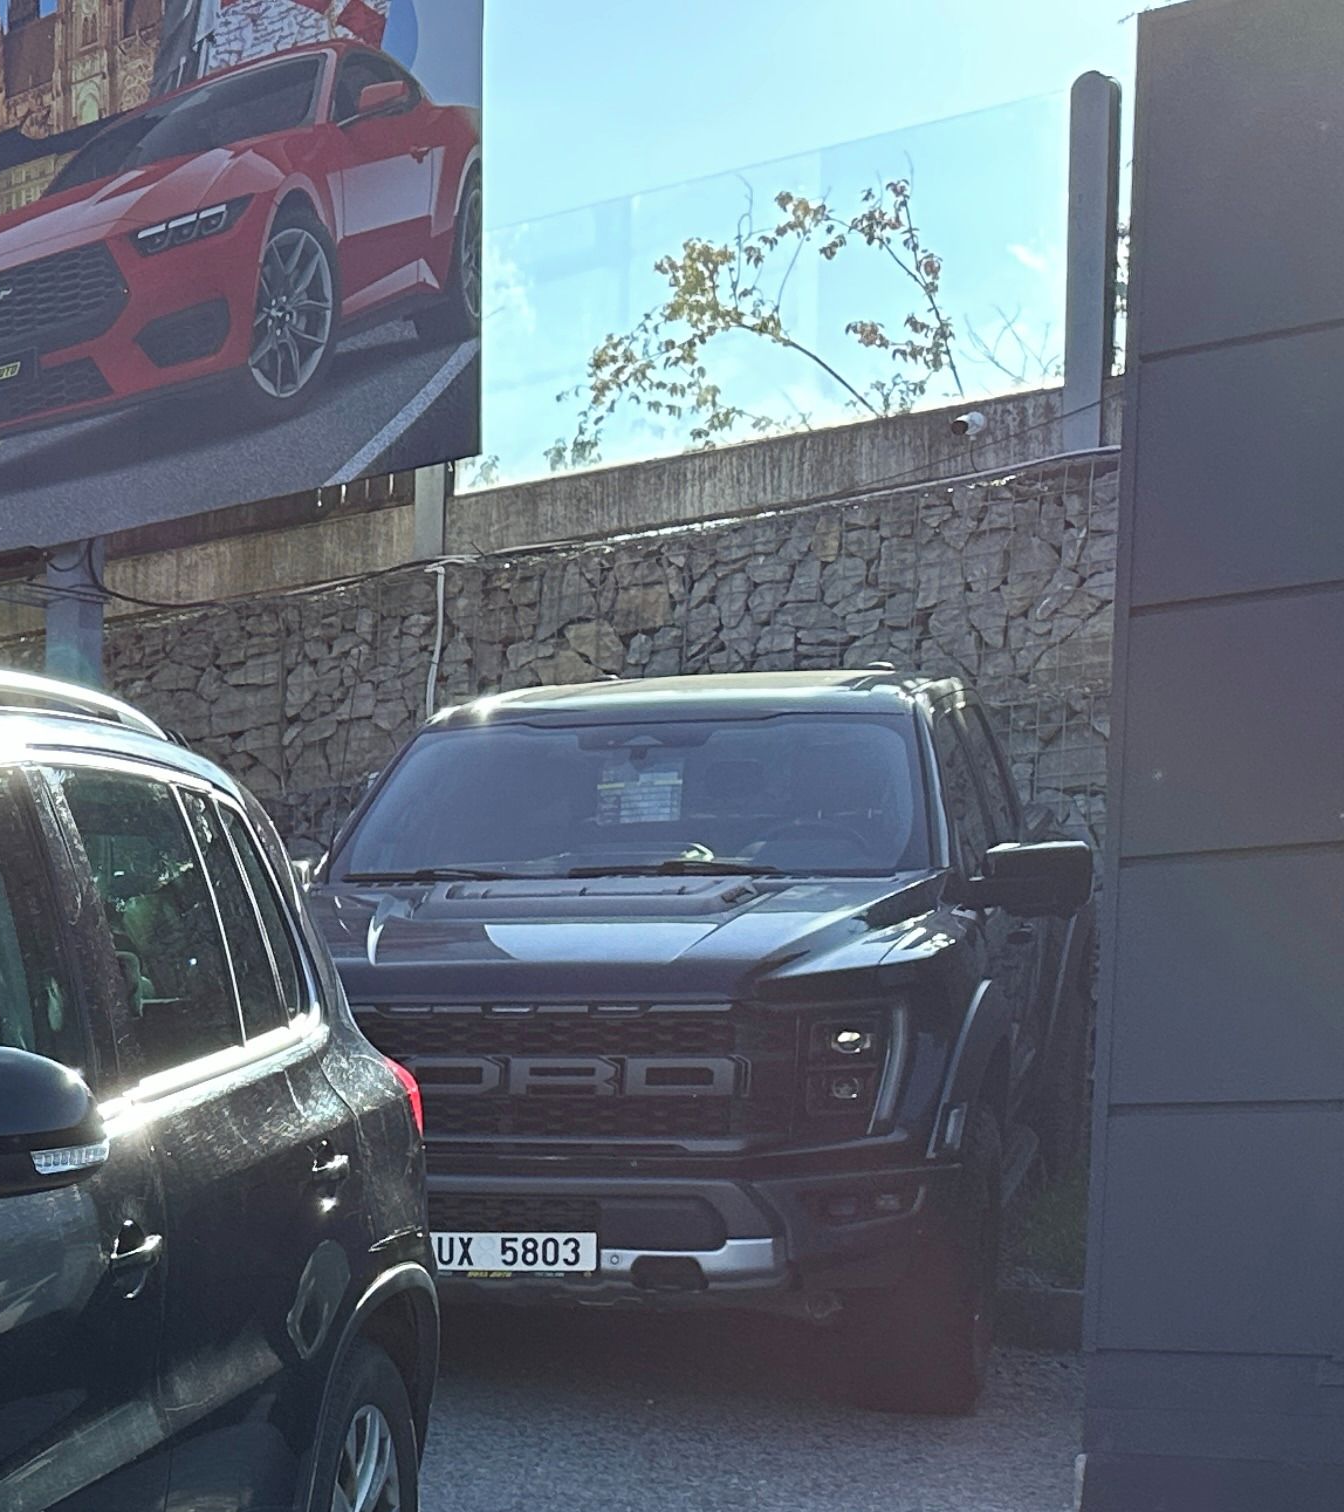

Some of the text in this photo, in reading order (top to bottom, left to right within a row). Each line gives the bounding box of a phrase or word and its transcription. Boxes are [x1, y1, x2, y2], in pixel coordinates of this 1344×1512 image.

[410, 1055, 753, 1097] ORD
[436, 1237, 581, 1267] UX 5803
